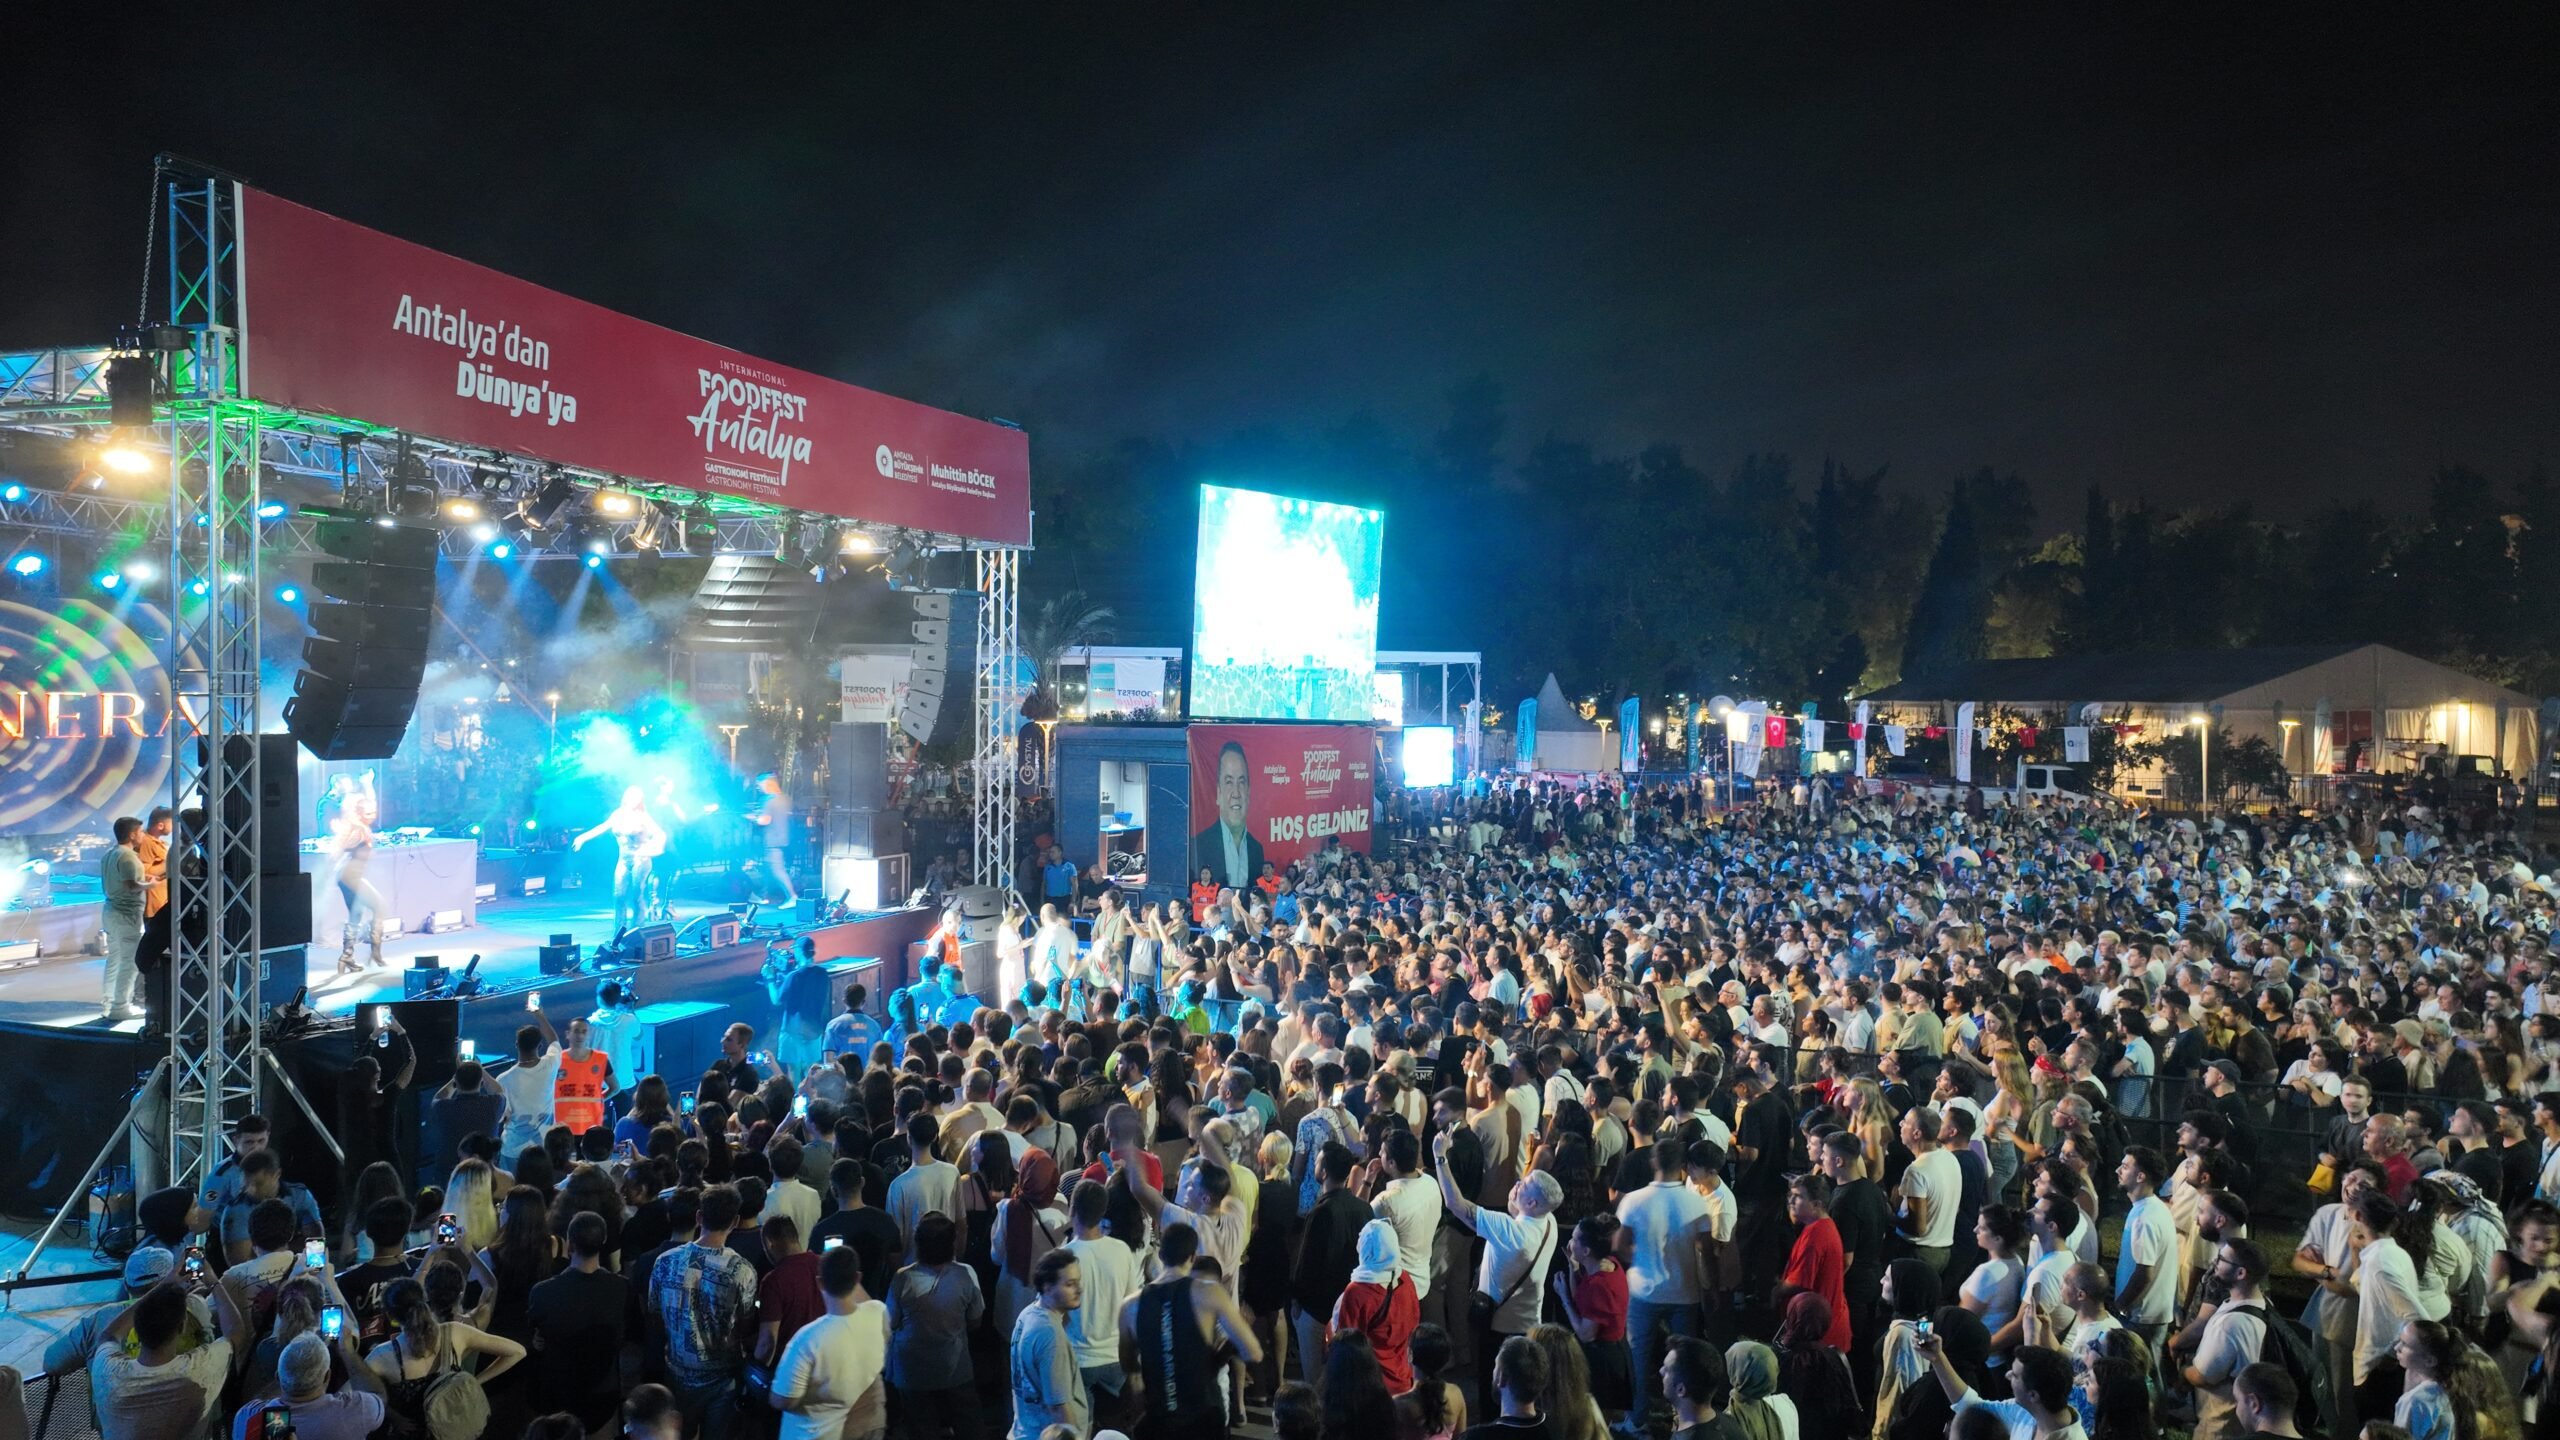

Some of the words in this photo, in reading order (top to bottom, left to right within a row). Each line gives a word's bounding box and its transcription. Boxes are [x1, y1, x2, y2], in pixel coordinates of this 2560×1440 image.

[393, 294, 549, 370] Antalya'dan
[456, 361, 577, 426] Dünya'ya
[698, 368, 807, 422] FOODFEST
[720, 360, 787, 387] INTERNATIONAL
[686, 389, 812, 486] Antalya
[705, 474, 751, 490] GASTRONOMY
[753, 483, 781, 497] FESTIVAL
[931, 463, 967, 483] Muhittin
[968, 469, 996, 489] BÖCEK
[1022, 737, 1034, 782] CRYSTAL
[1300, 759, 1341, 792] Antalya
[1303, 750, 1340, 763] FOODFEST
[1270, 815, 1304, 844] HOŞ
[1307, 803, 1369, 838] GELDİNİZ
[1414, 1072, 1433, 1080] ANS
[1161, 1301, 1173, 1351] UNDER
[1163, 1353, 1177, 1411] ARMOUR
